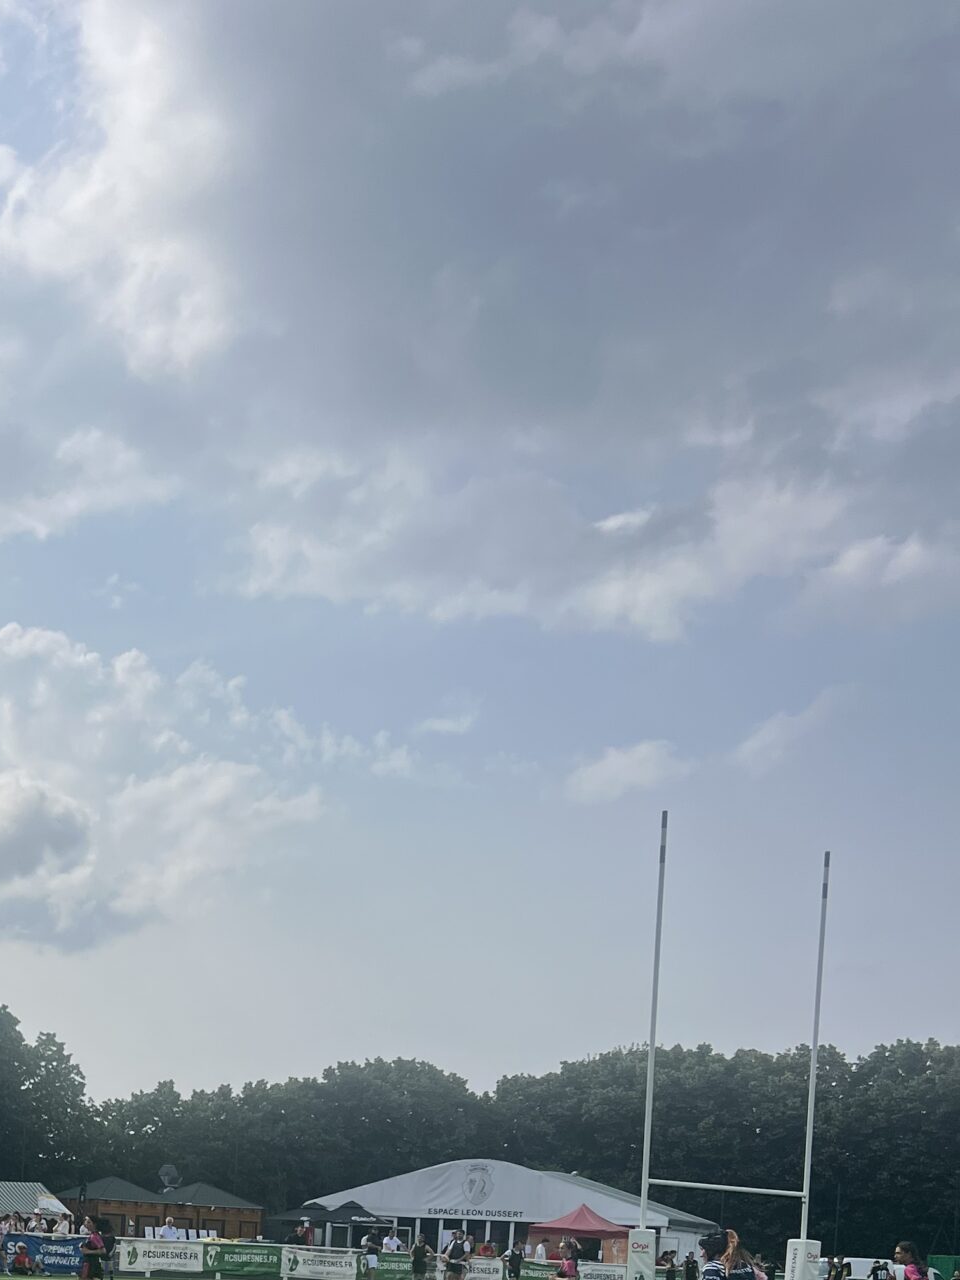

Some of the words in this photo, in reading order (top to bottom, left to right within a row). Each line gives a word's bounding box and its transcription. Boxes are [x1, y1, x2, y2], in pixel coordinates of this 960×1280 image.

[428, 1208, 459, 1216] ESPACE
[486, 1210, 523, 1218] DUSSERT
[142, 1250, 199, 1260] RCSURESNES.FR
[224, 1254, 278, 1263] RCSURESNES.FR
